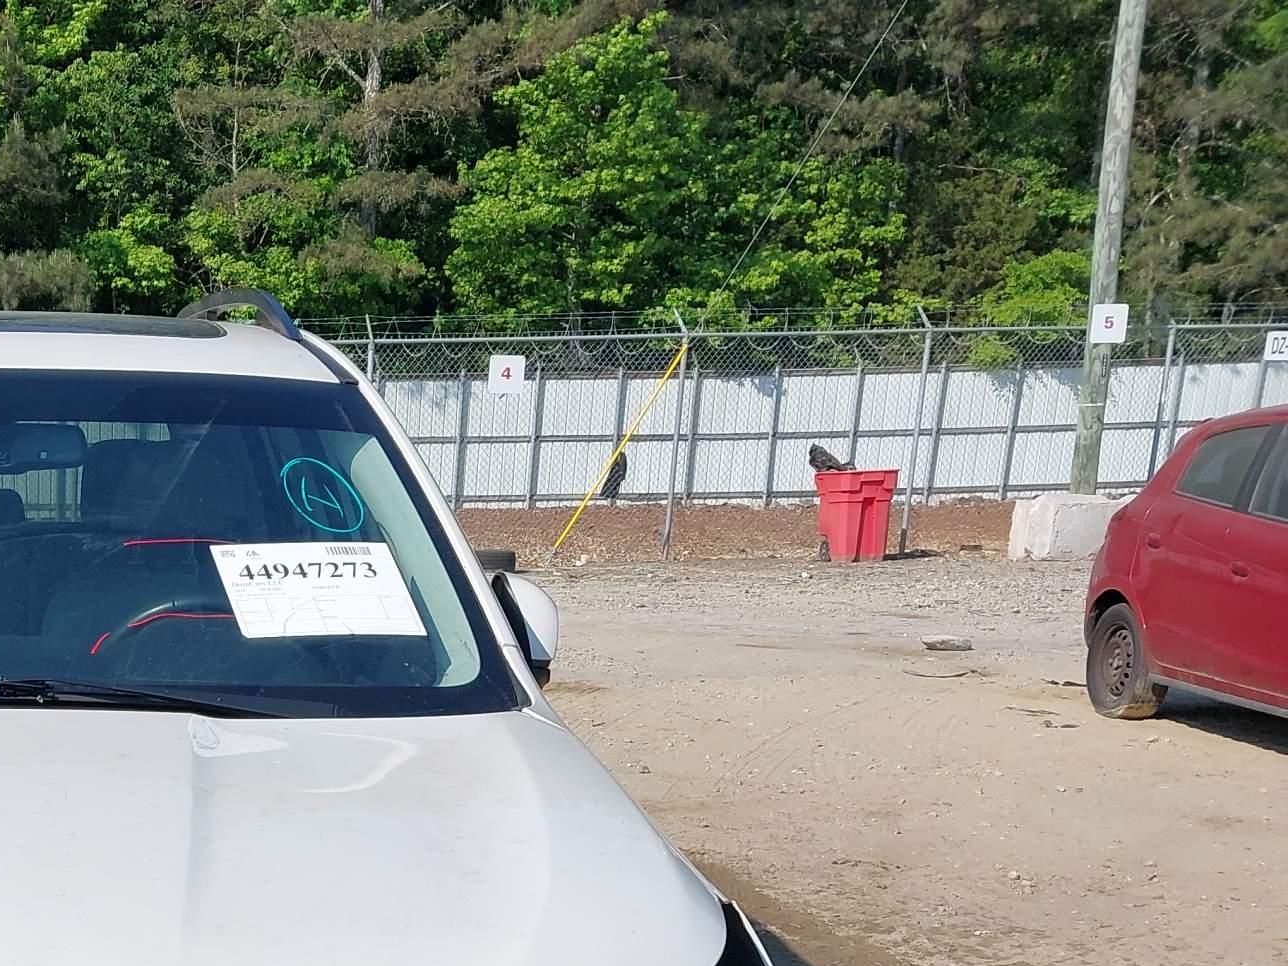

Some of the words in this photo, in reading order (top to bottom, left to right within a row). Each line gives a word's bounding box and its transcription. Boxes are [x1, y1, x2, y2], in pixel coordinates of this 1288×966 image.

[1103, 315, 1115, 330] 5
[500, 366, 513, 380] 4
[238, 562, 378, 580] 44947273
